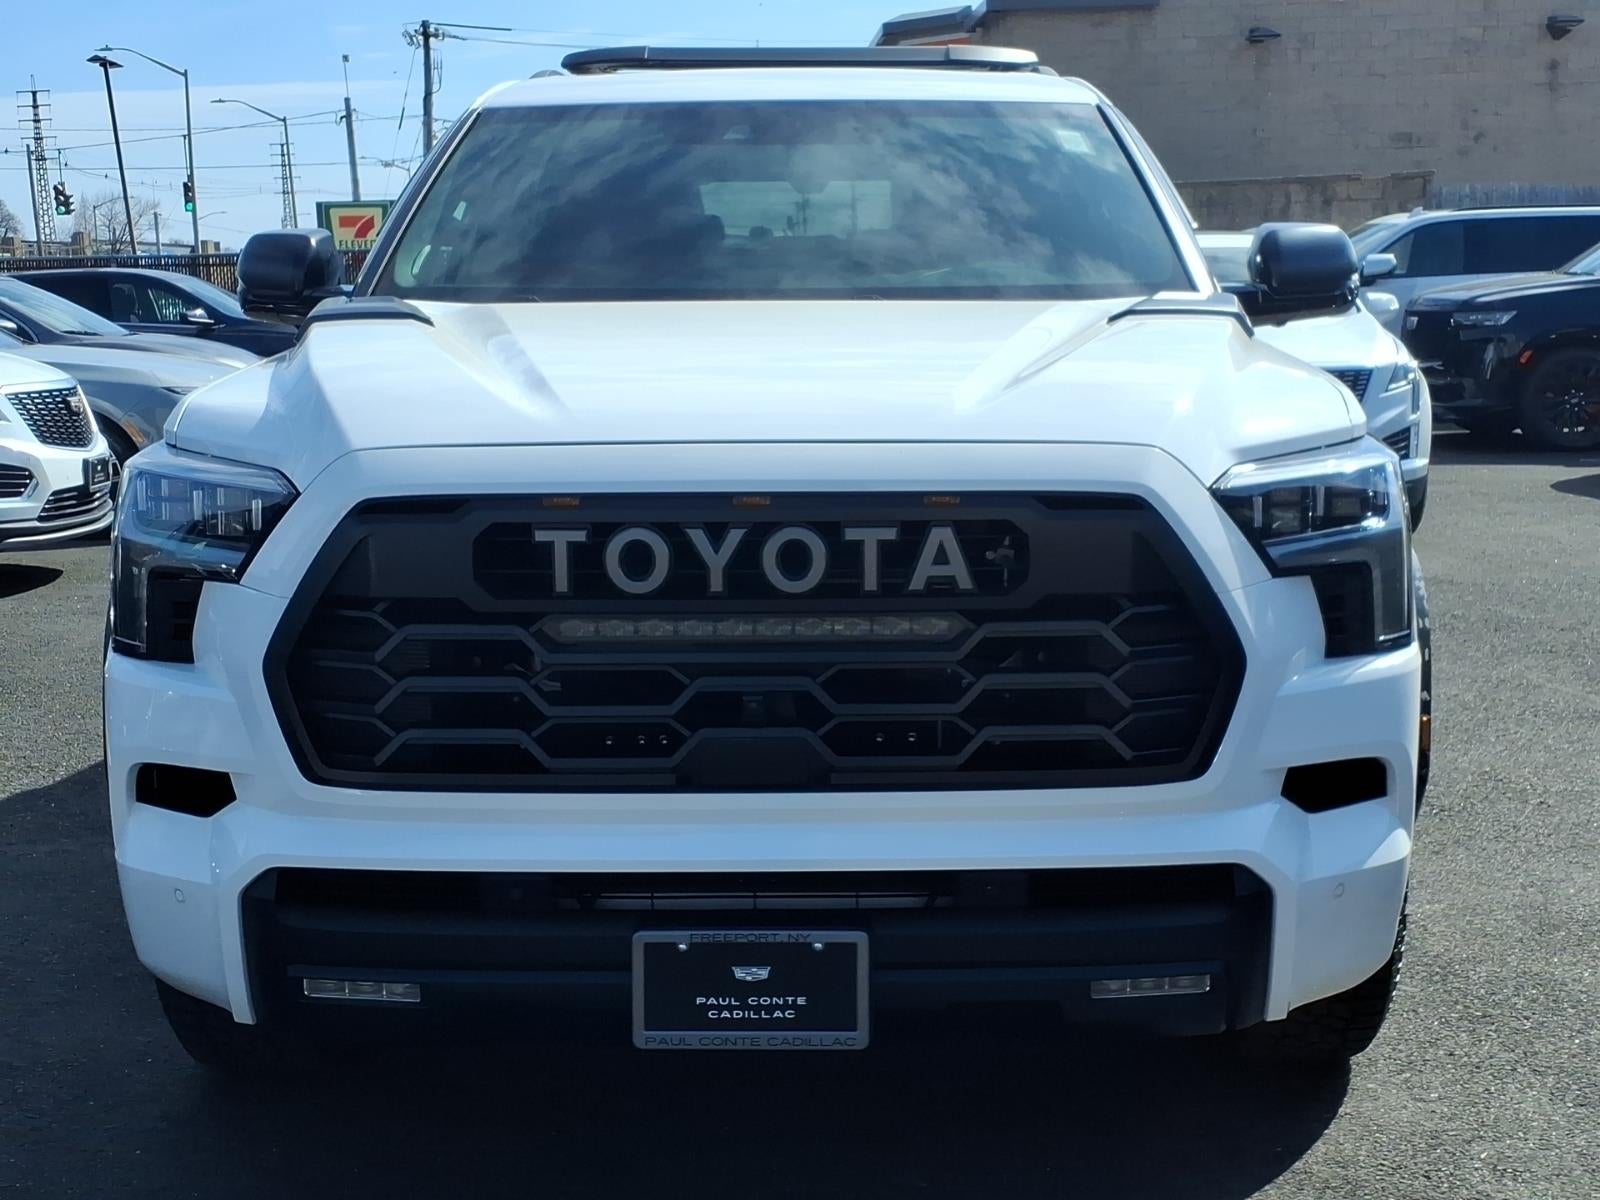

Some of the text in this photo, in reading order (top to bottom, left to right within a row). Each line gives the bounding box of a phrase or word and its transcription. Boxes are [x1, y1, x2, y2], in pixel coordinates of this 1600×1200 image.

[338, 215, 376, 239] 7
[533, 525, 975, 594] TOYOTA
[787, 932, 811, 943] NY
[696, 996, 808, 1005] PAUL CONTE
[707, 1009, 797, 1019] CADILLAC
[644, 1036, 857, 1047] PAUL CONTE CADILLAC
